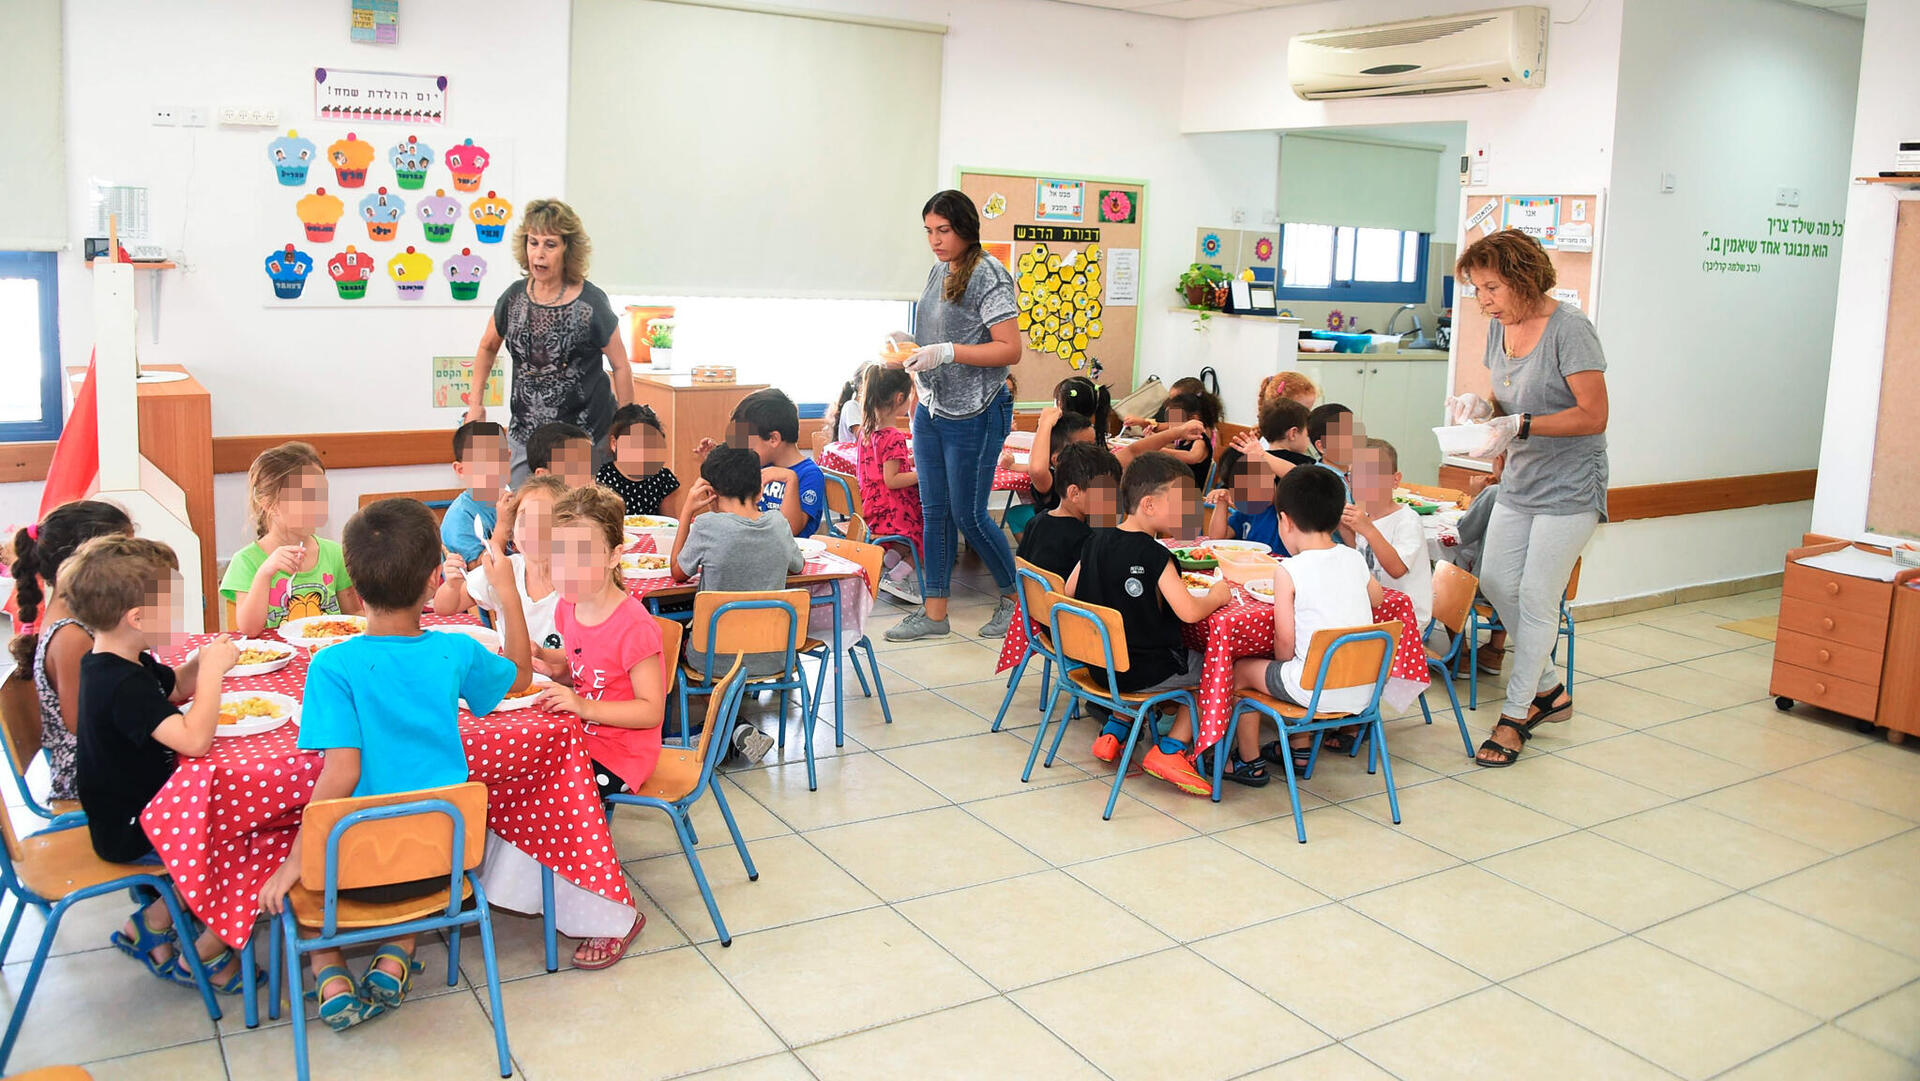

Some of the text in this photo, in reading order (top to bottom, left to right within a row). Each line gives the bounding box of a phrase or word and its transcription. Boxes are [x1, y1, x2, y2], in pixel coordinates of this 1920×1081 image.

[328, 85, 438, 101] יום הולדת שמח!
[1768, 217, 1789, 236] צריך
[1792, 216, 1815, 234] שילד
[1817, 222, 1830, 236] מה
[1016, 226, 1100, 241] דבורת הדבש
[1723, 238, 1758, 256] שיאמין
[1760, 239, 1781, 255] אחד
[1783, 241, 1810, 257] מבוגר
[1811, 244, 1828, 258] הוא
[436, 369, 462, 380] הקסם
